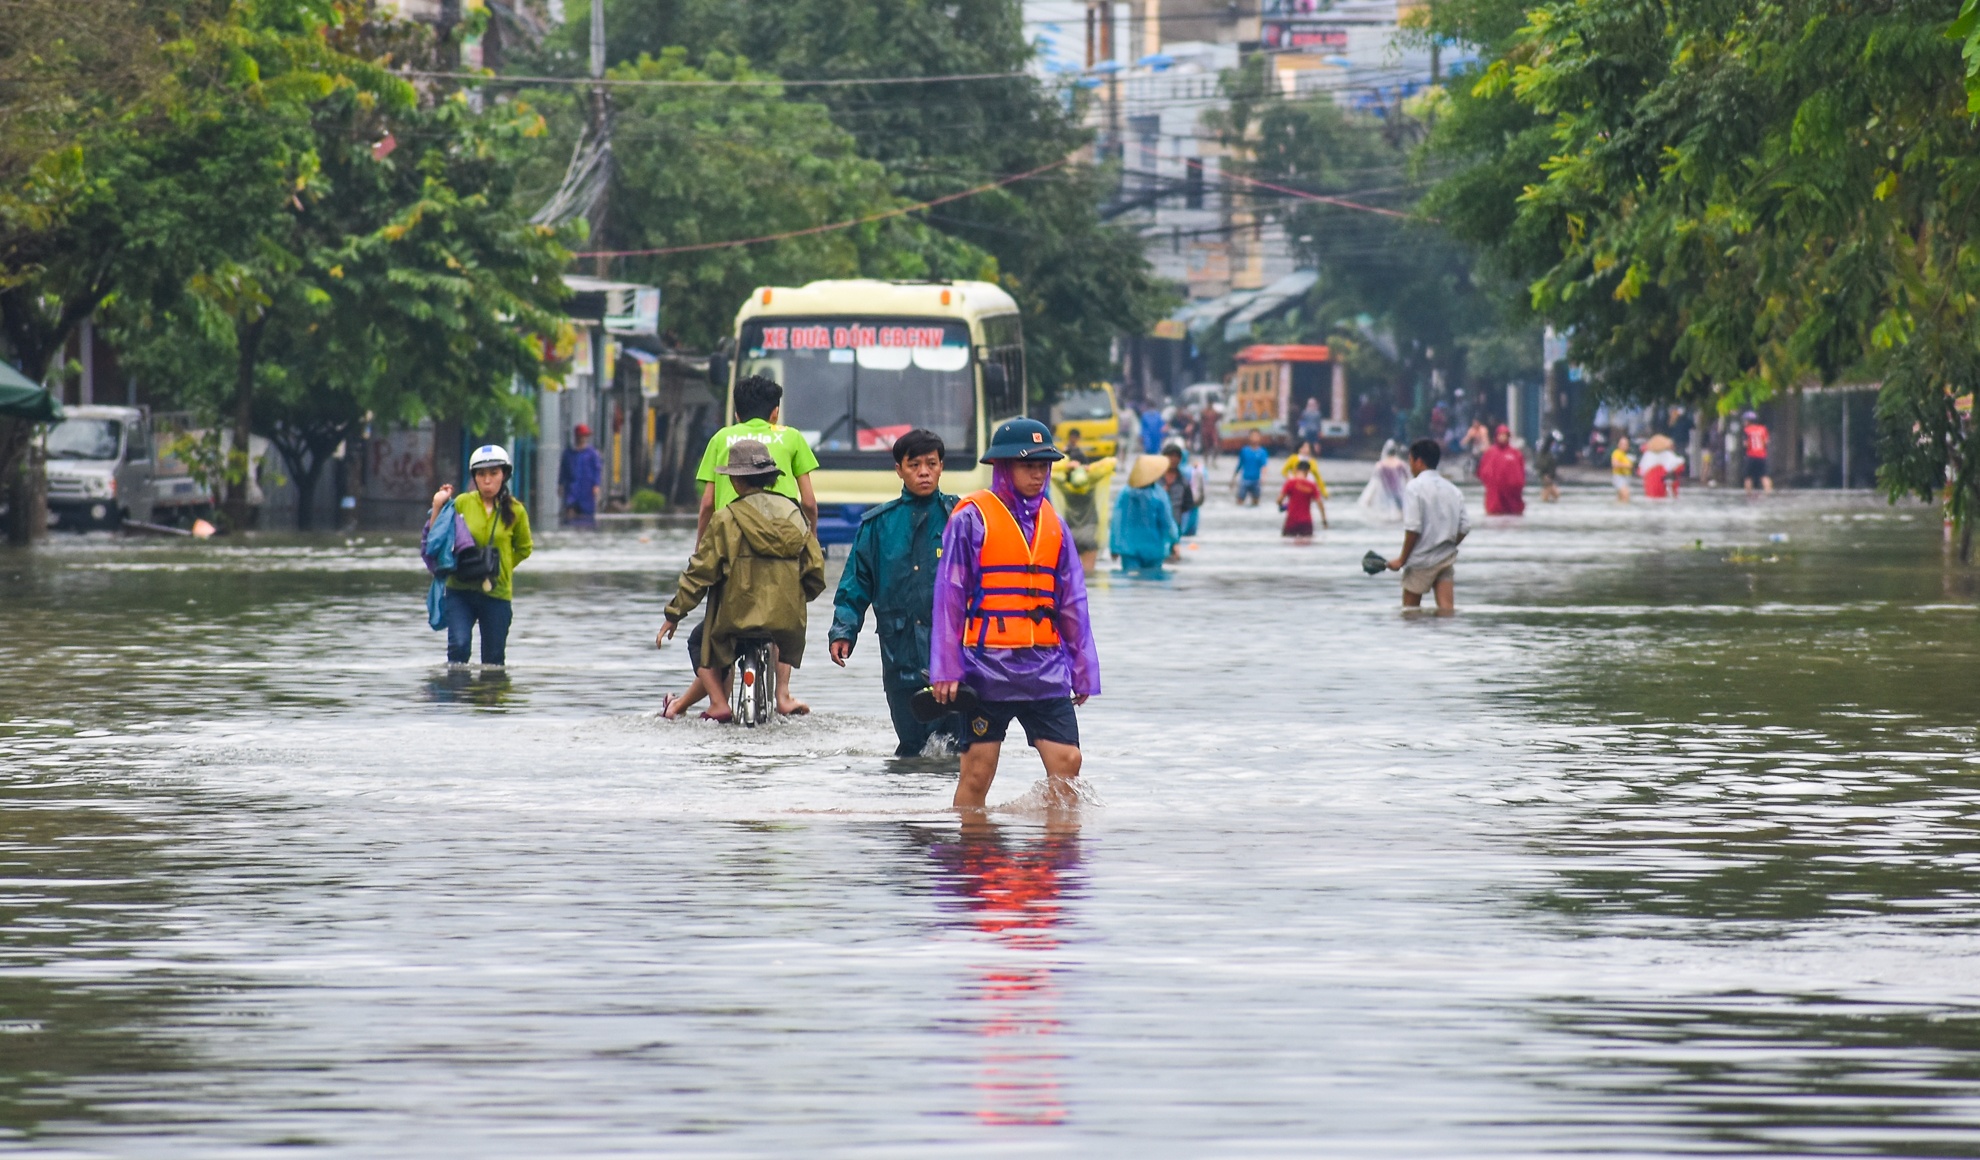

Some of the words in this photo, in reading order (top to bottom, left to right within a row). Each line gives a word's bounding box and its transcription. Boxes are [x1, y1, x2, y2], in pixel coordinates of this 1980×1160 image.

[762, 327, 788, 349] XE
[791, 325, 831, 349] ĐƯA
[878, 327, 944, 348] CBCNV
[773, 432, 784, 445] X
